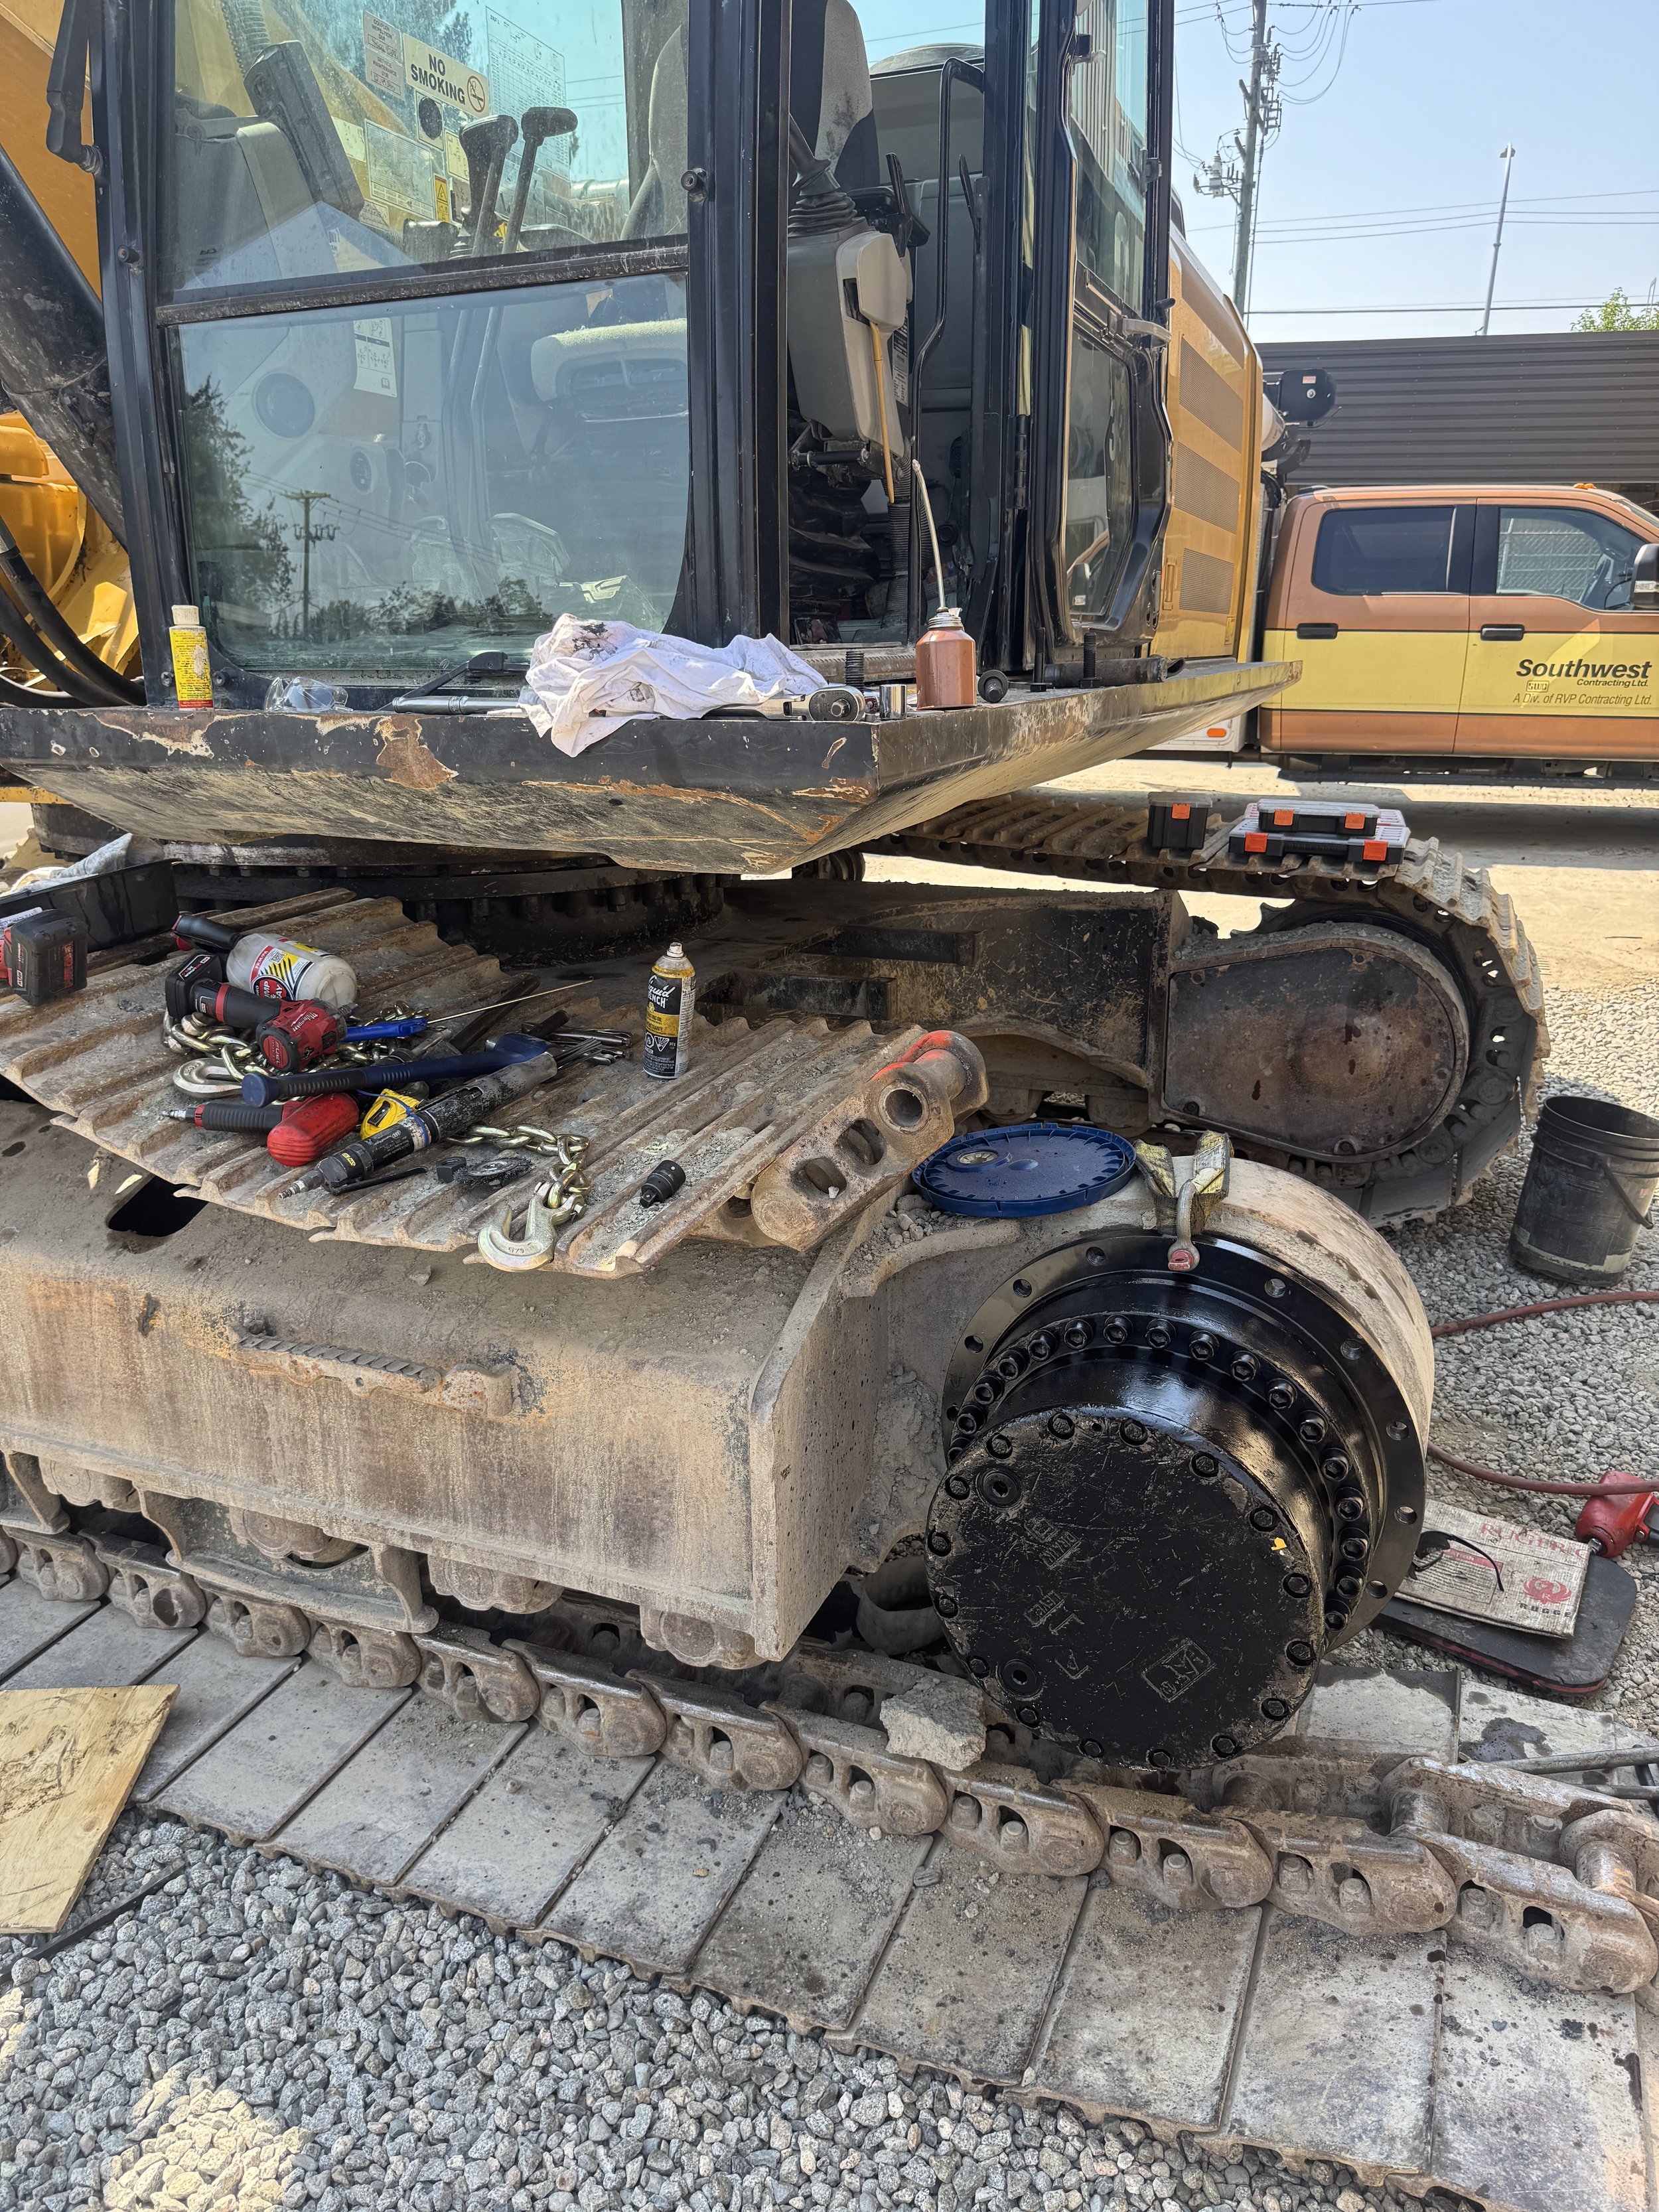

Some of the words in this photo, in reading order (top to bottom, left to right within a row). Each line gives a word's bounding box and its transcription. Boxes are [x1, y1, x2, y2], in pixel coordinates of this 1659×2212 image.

[429, 53, 446, 76] NO
[411, 63, 466, 106] SMOKING
[1516, 659, 1652, 679] Southwest
[1577, 678, 1629, 688] Contracting
[1513, 694, 1520, 703] A
[1522, 694, 1540, 703] Div.
[1543, 694, 1553, 703] of
[1555, 694, 1577, 704] RVP
[1578, 694, 1632, 707] Contracting
[1634, 695, 1652, 705] Ltd.
[1480, 1522, 1575, 1556] RUGER
